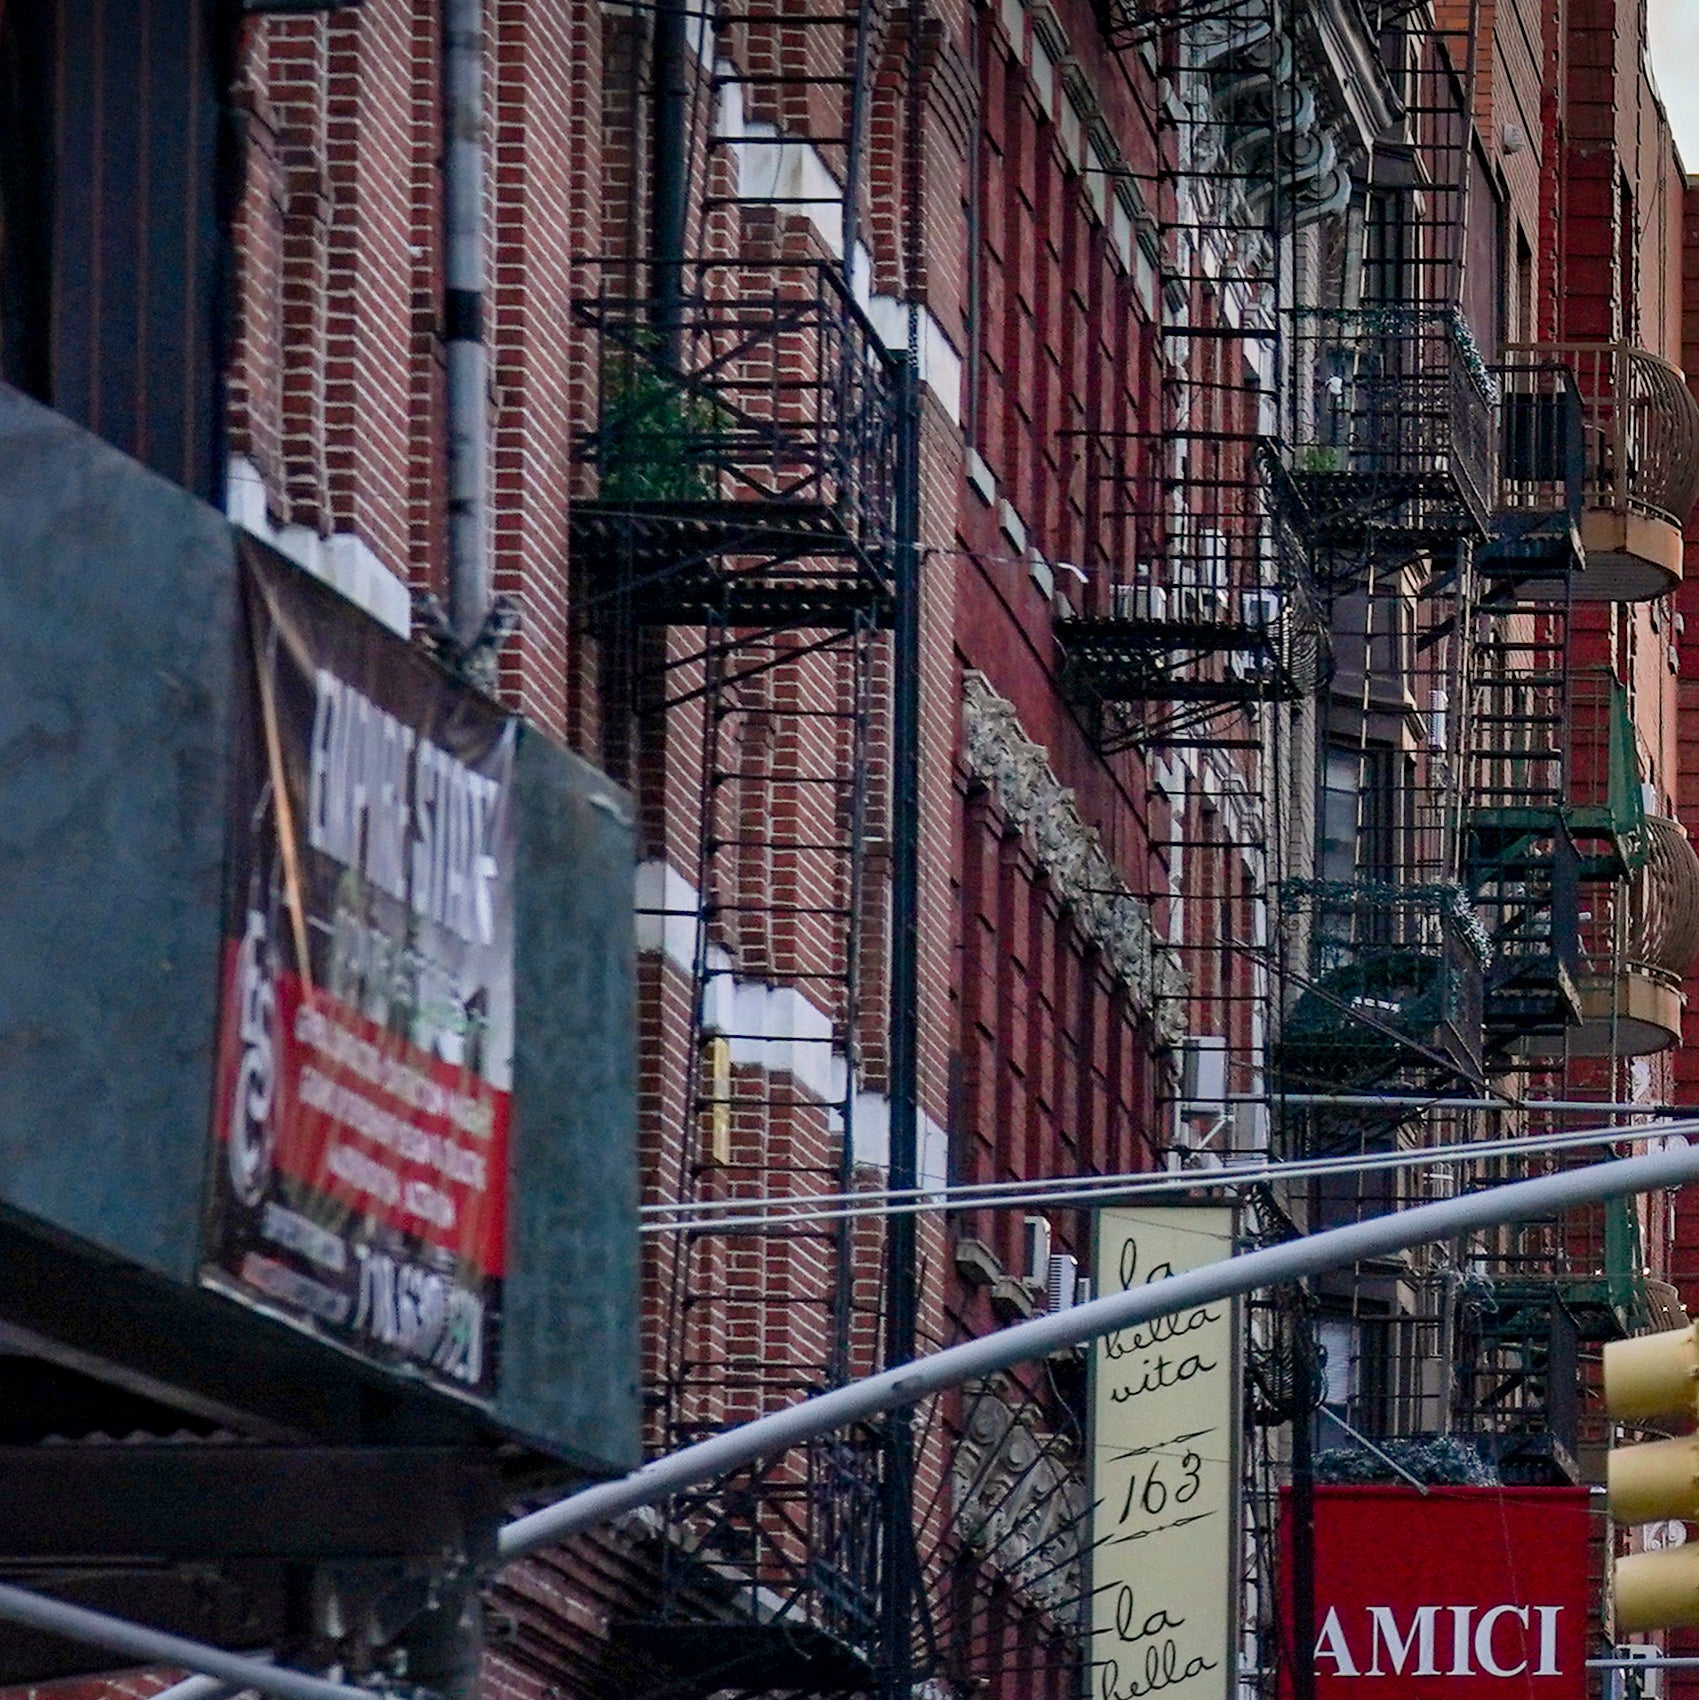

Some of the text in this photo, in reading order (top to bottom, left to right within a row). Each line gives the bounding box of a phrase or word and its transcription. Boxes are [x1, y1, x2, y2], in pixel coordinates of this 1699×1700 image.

[1110, 1353, 1218, 1404] vita
[1118, 1449, 1202, 1525] 163
[1114, 1585, 1186, 1643] la
[1312, 1604, 1564, 1679] AMICI
